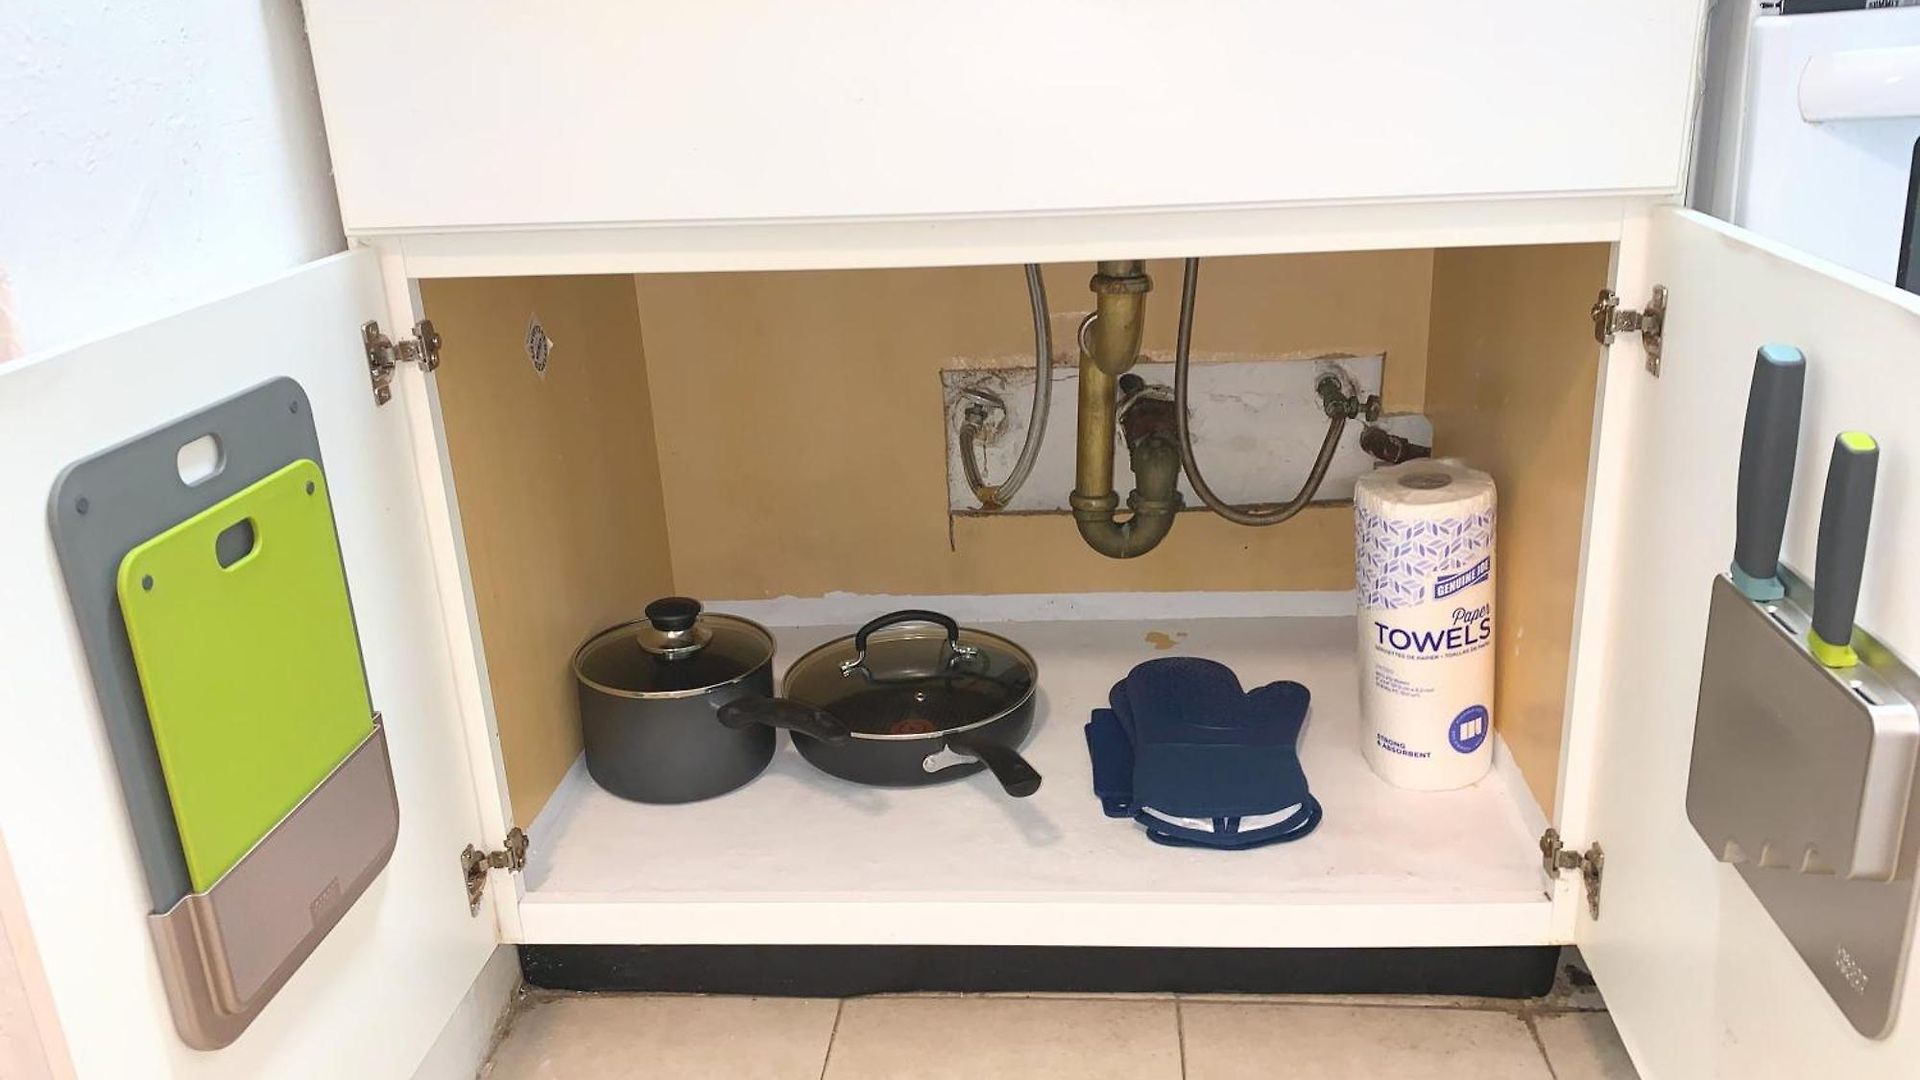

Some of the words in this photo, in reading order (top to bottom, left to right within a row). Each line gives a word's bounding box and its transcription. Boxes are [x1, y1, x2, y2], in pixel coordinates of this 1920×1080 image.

[1437, 569, 1477, 597] GENUINE
[1452, 603, 1490, 625] Paper
[1374, 618, 1491, 653] TOWELS
[1376, 733, 1405, 748] STRONG
[1382, 743, 1431, 758] ABSORBENT
